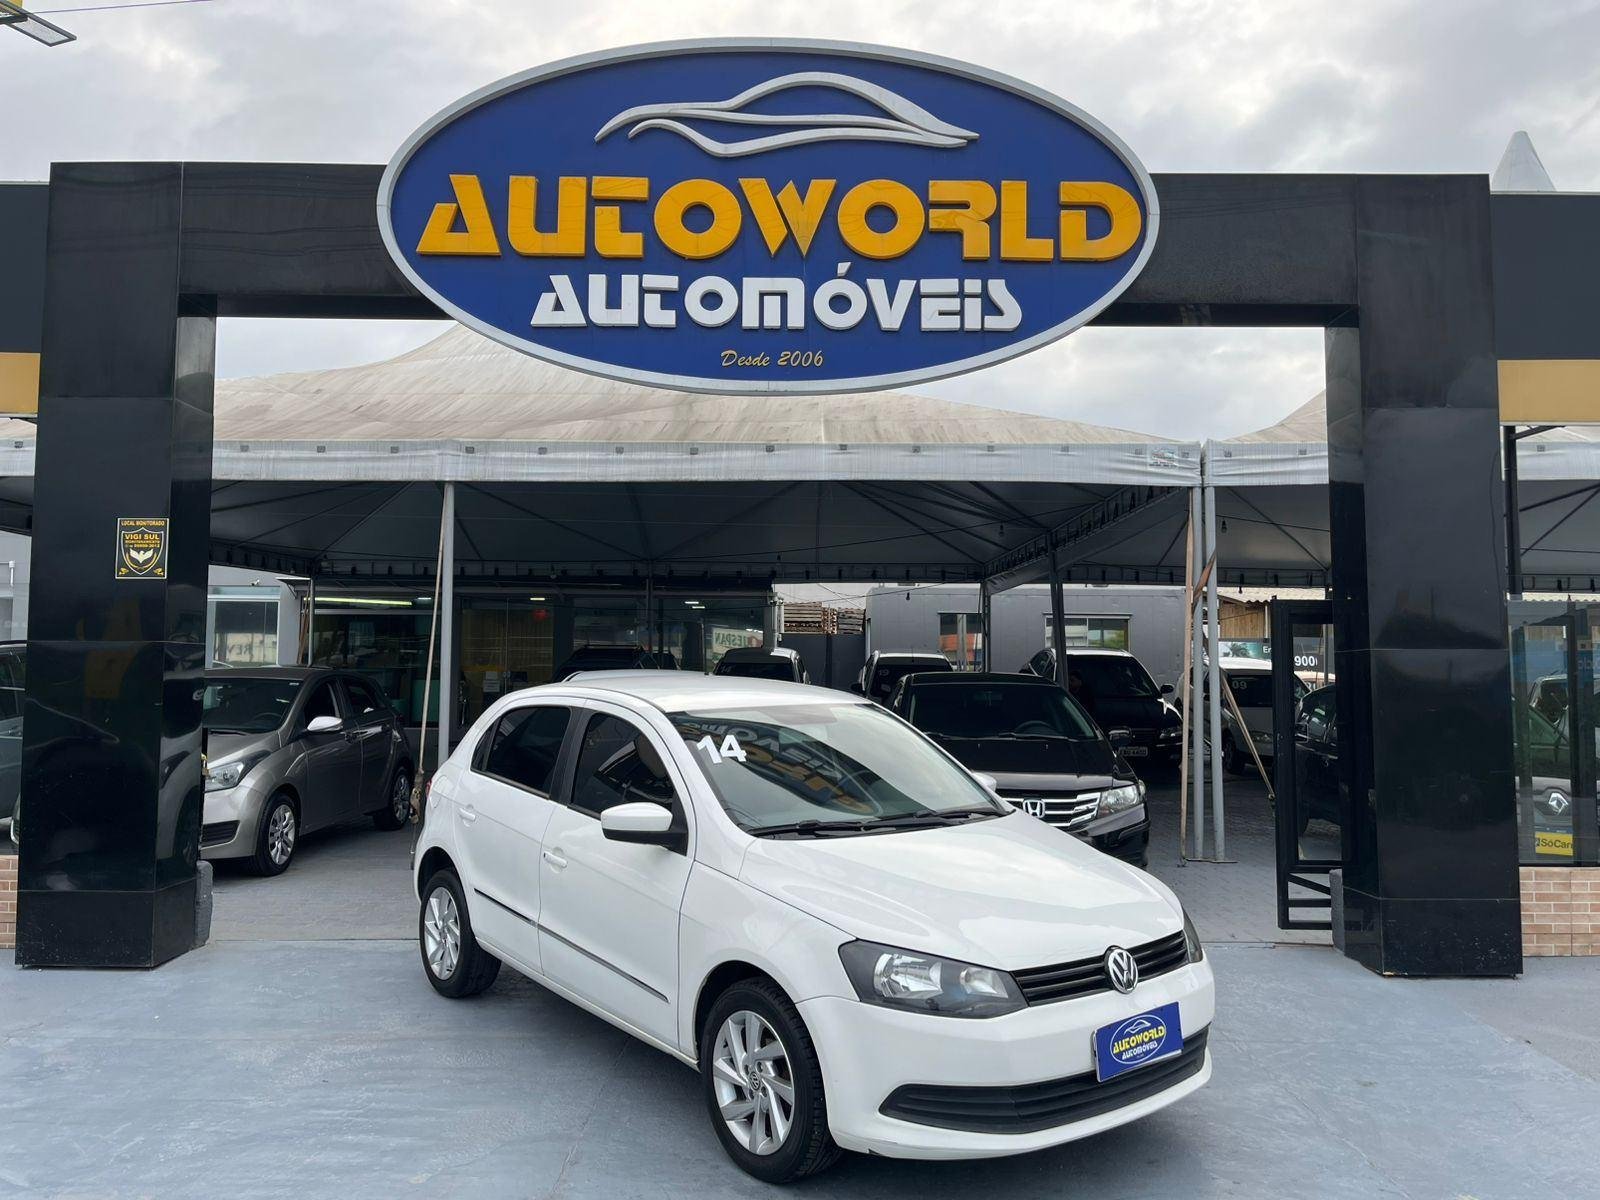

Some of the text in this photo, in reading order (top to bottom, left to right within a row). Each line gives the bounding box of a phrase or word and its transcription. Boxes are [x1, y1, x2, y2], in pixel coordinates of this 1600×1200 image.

[416, 173, 1142, 262] AUTOWORLD
[720, 349, 823, 367] Desde 2006
[697, 734, 747, 764] 14
[1113, 1025, 1165, 1055] AUTOWORLD
